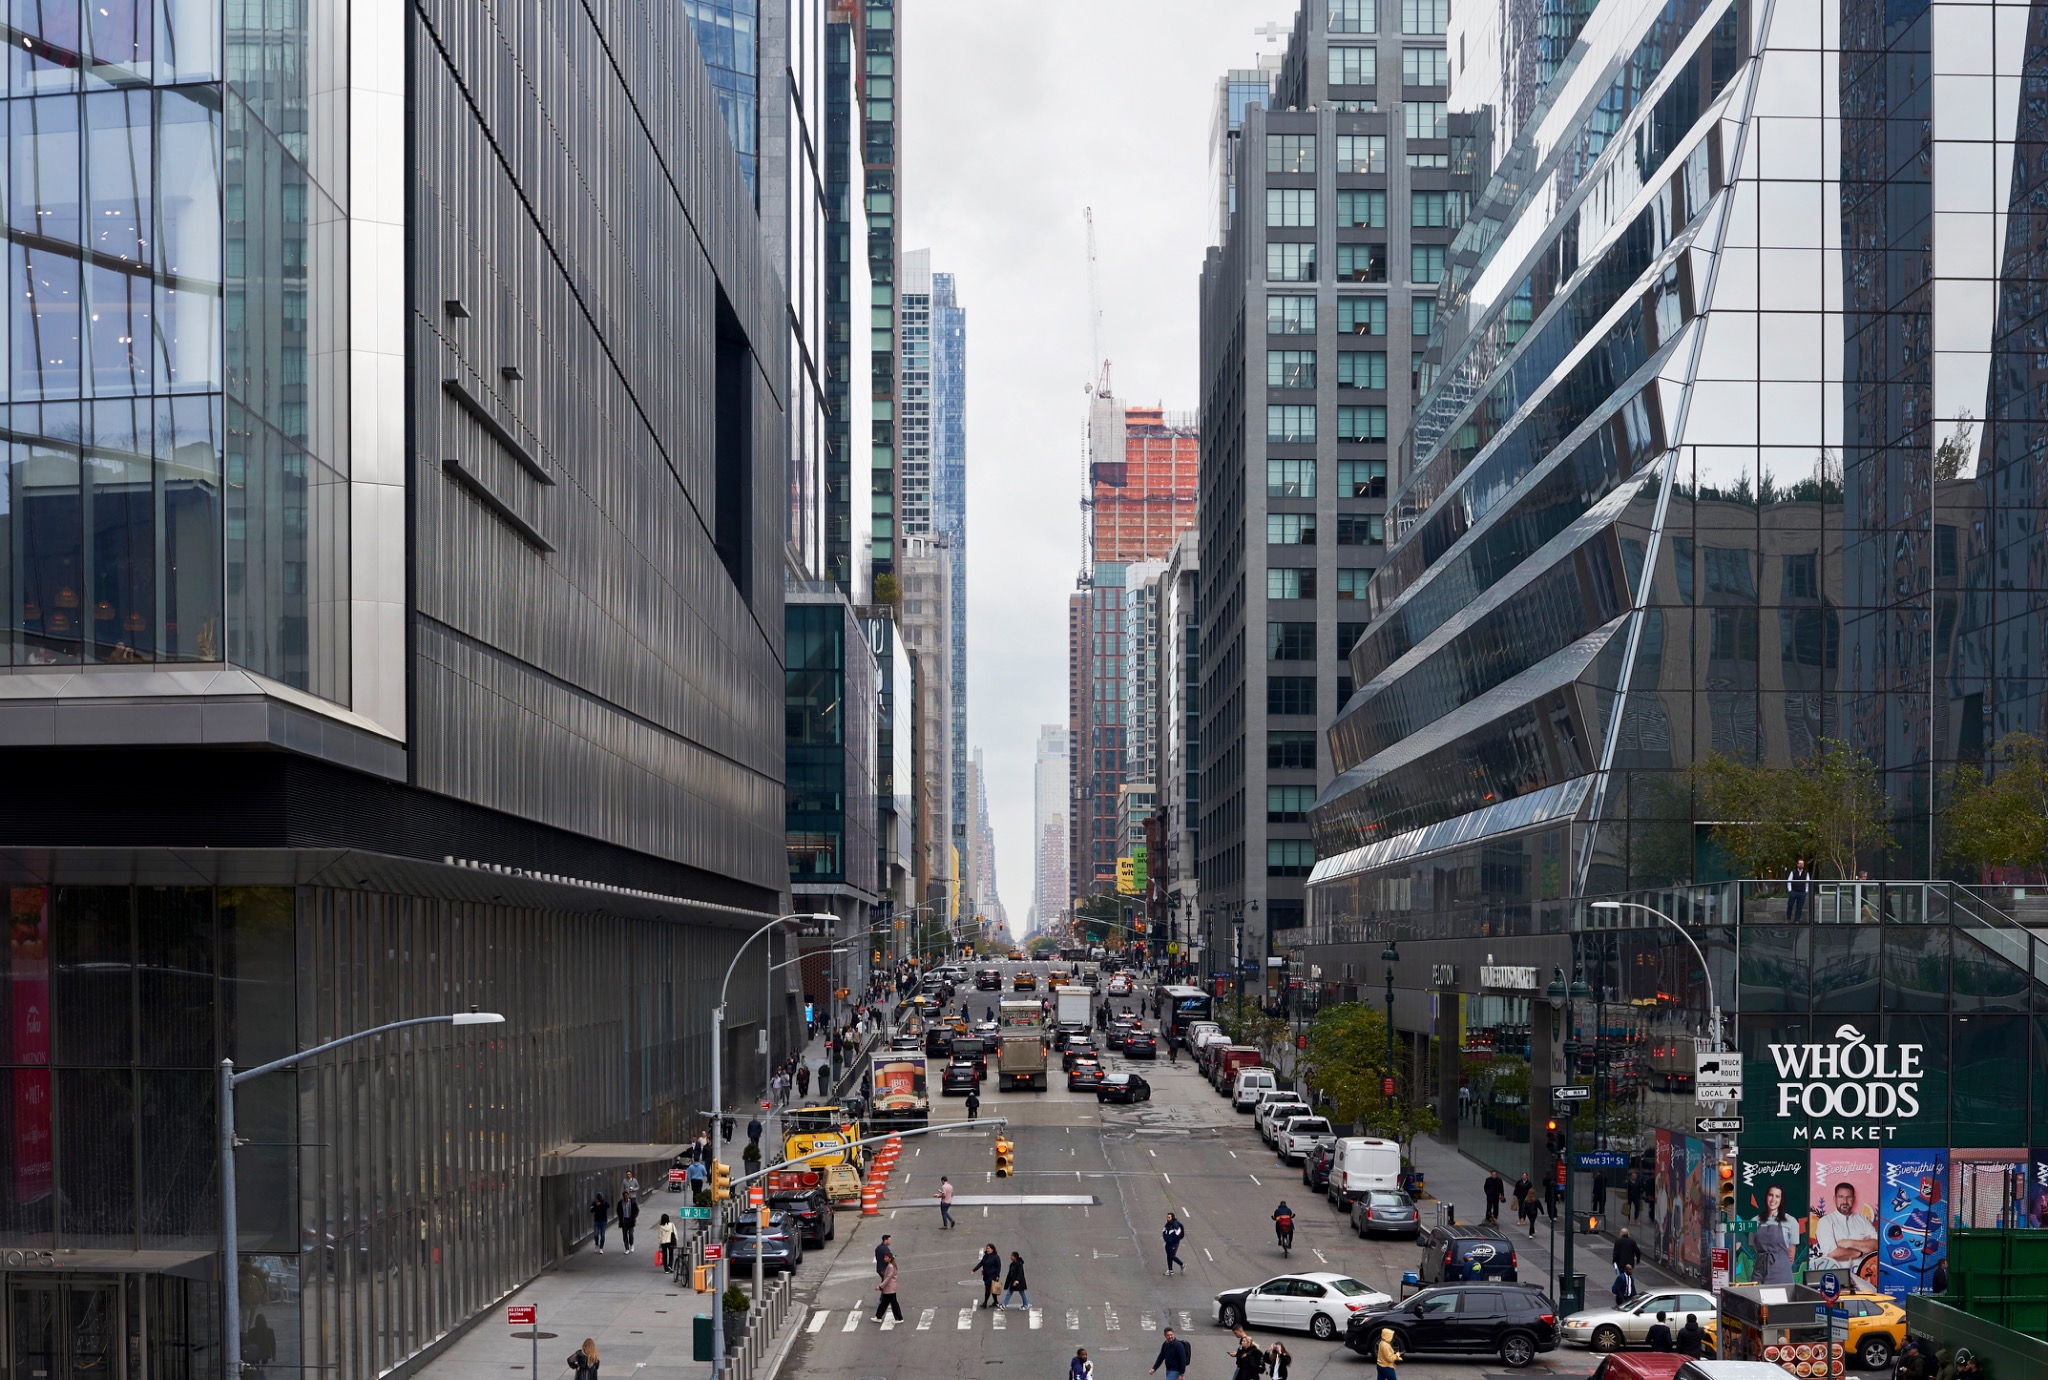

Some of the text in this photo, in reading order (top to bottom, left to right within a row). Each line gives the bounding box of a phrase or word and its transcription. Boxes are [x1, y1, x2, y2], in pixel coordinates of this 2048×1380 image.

[1432, 965, 1454, 984] PELOTON
[1768, 1043, 1924, 1079] WHOLE
[1776, 1082, 1920, 1118] FOODS
[1792, 1126, 1898, 1140] MARKET
[20, 1161, 51, 1176] sweetgreen
[1750, 1161, 1801, 1176] Everything
[1824, 1161, 1873, 1176] Everything
[684, 1208, 690, 1217] W
[694, 1208, 700, 1217] 31
[1730, 1223, 1735, 1231] W
[1739, 1223, 1745, 1231] 31
